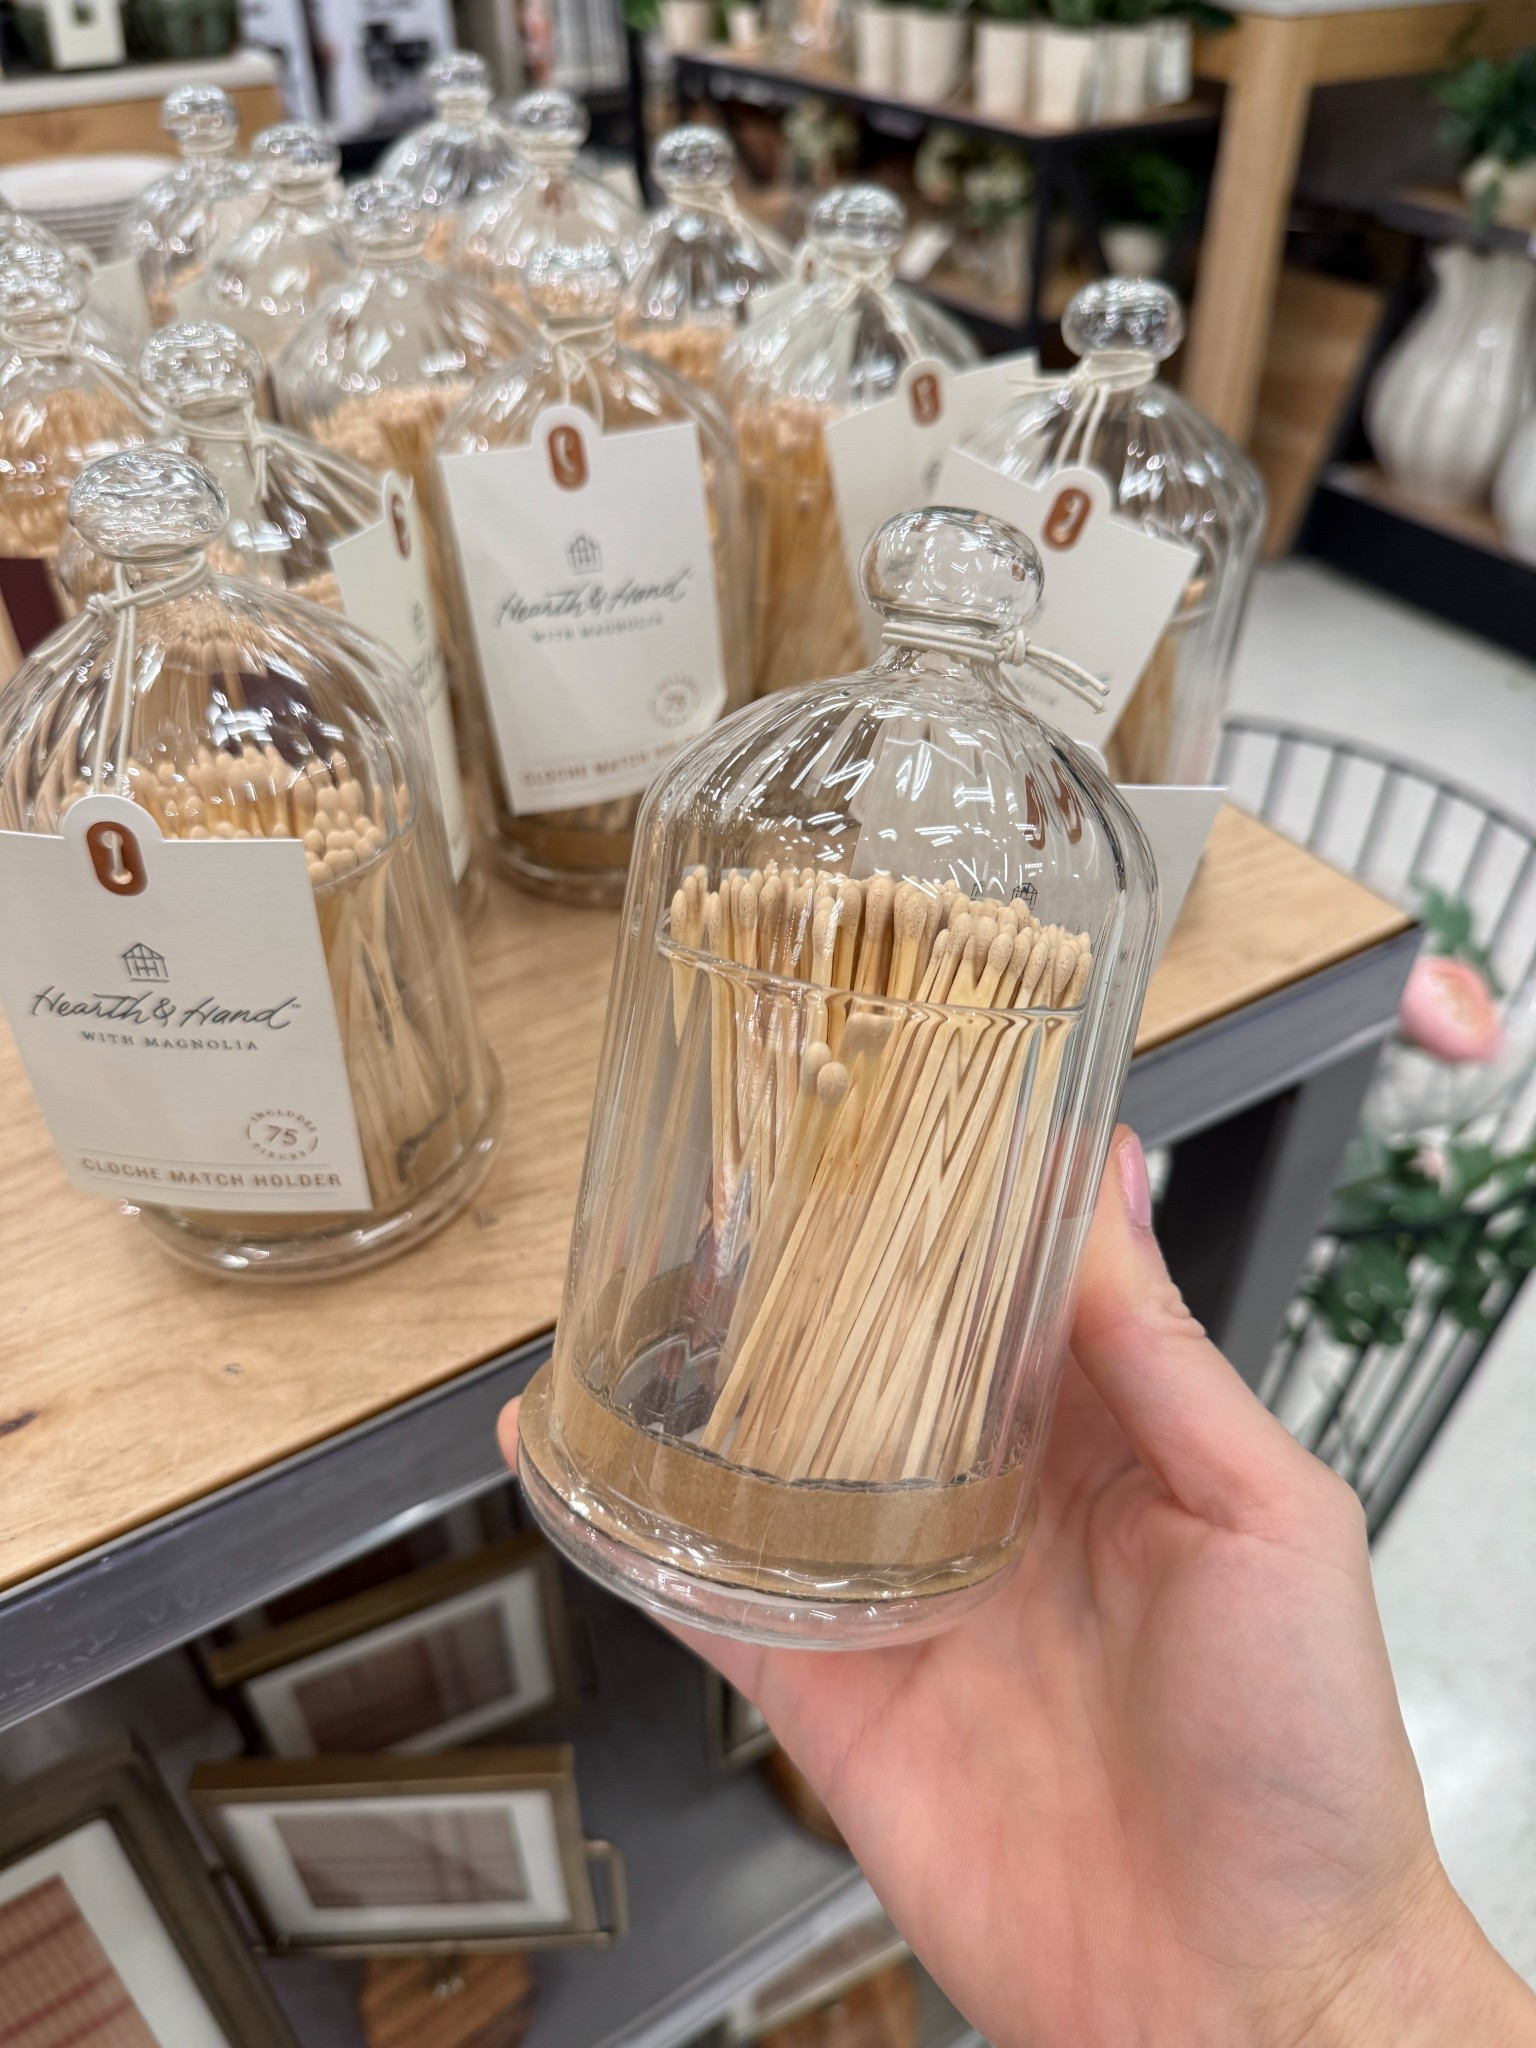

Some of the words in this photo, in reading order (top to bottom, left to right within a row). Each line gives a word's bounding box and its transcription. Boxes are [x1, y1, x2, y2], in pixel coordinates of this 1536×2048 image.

[494, 580, 591, 628] Hearth
[587, 583, 608, 616] &
[607, 566, 693, 614] Hand
[31, 985, 153, 1024] Hearth
[152, 997, 177, 1027] &
[80, 1030, 135, 1046] WITH
[144, 1036, 260, 1051] MAGNOLIA
[266, 1124, 299, 1146] 75
[81, 1156, 163, 1181] CLOCHE
[168, 1169, 246, 1188] MATCH
[254, 1172, 343, 1188] HOLDER
